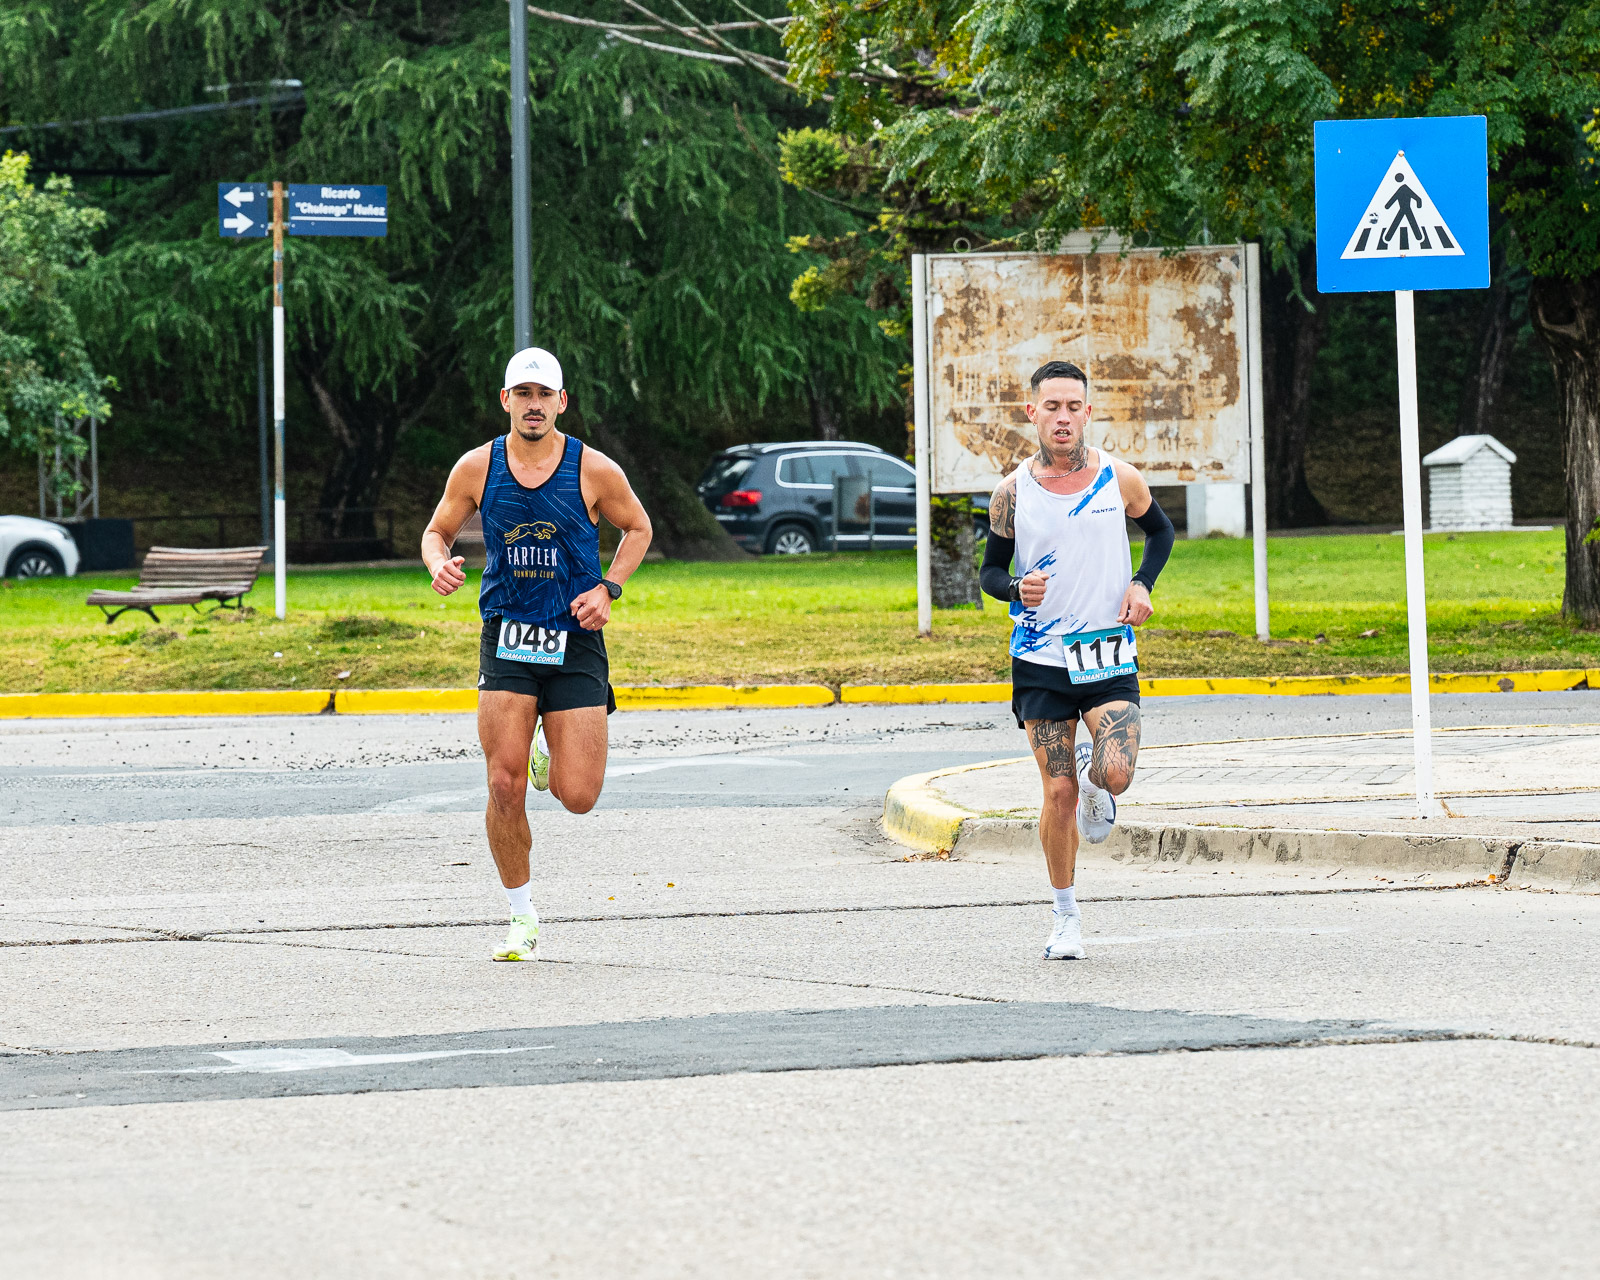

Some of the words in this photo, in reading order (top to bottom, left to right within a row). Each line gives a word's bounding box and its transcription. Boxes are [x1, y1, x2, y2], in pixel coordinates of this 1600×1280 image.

[321, 187, 361, 199] Ricardo
[295, 202, 352, 217] "Chulengo"
[507, 546, 558, 567] FARTLEK
[513, 569, 537, 578] RUNNING
[539, 570, 554, 579] CLUB
[503, 619, 561, 655] 048
[499, 651, 537, 662] DIAMANTE
[536, 655, 561, 664] CORRE
[1068, 634, 1123, 673] 117
[1074, 671, 1109, 682] DIAMANTE
[1110, 666, 1133, 676] CORRE
